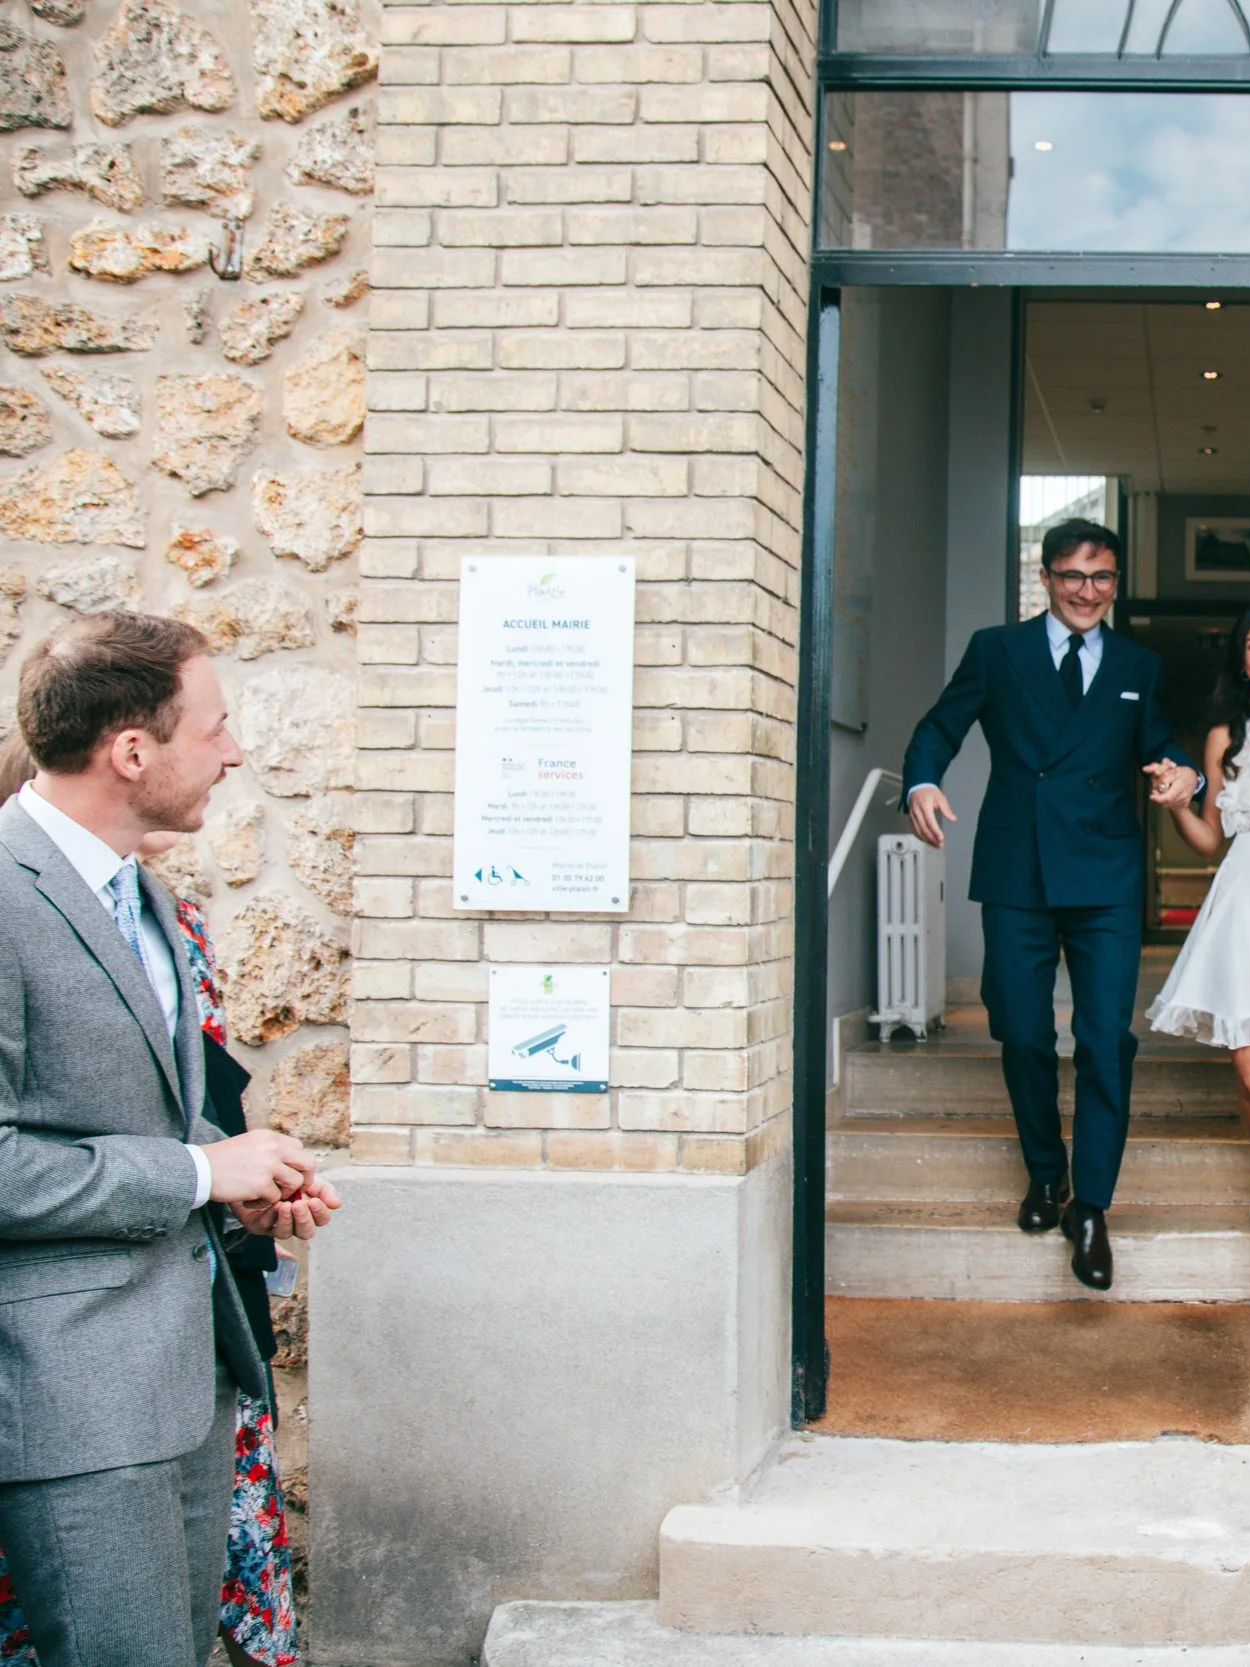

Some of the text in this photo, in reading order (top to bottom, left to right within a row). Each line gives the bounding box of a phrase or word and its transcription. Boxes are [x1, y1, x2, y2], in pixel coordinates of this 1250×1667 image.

[502, 619, 591, 630] ACCUEIL MAIRIE
[506, 644, 529, 653] Lundi
[566, 660, 600, 668] vendredi
[508, 700, 538, 708] Samedi
[537, 758, 577, 769] France
[537, 770, 584, 780] services
